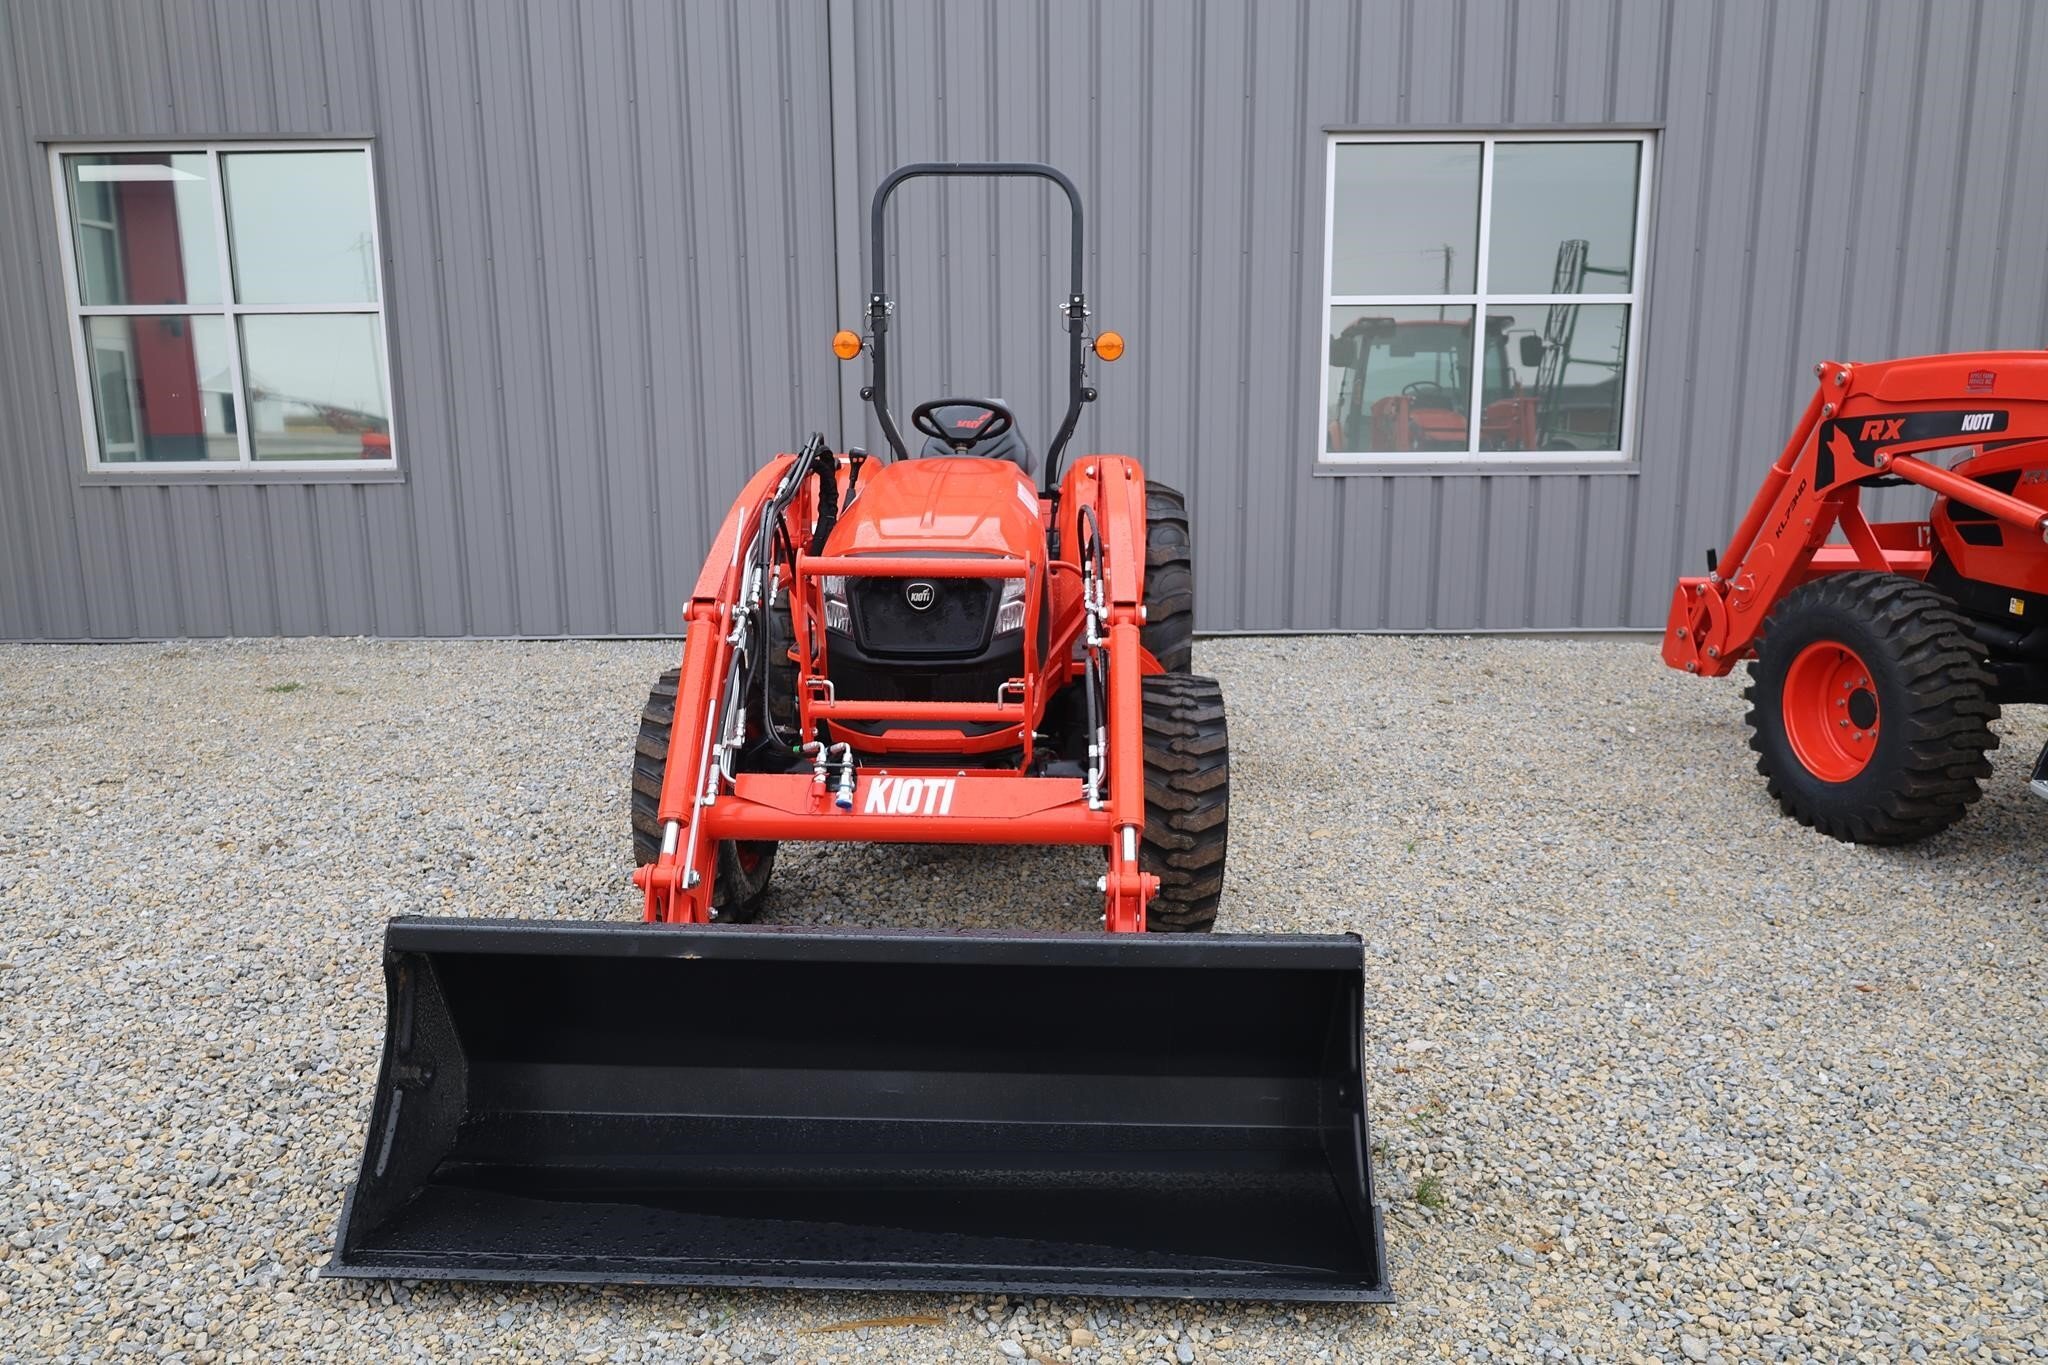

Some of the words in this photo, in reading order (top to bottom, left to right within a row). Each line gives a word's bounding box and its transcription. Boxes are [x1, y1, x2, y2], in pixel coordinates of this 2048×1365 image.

[1859, 418, 1906, 441] RX
[1961, 413, 1994, 432] KIOTI
[1776, 478, 1807, 539] KL7340
[863, 777, 956, 816] KIOTI
